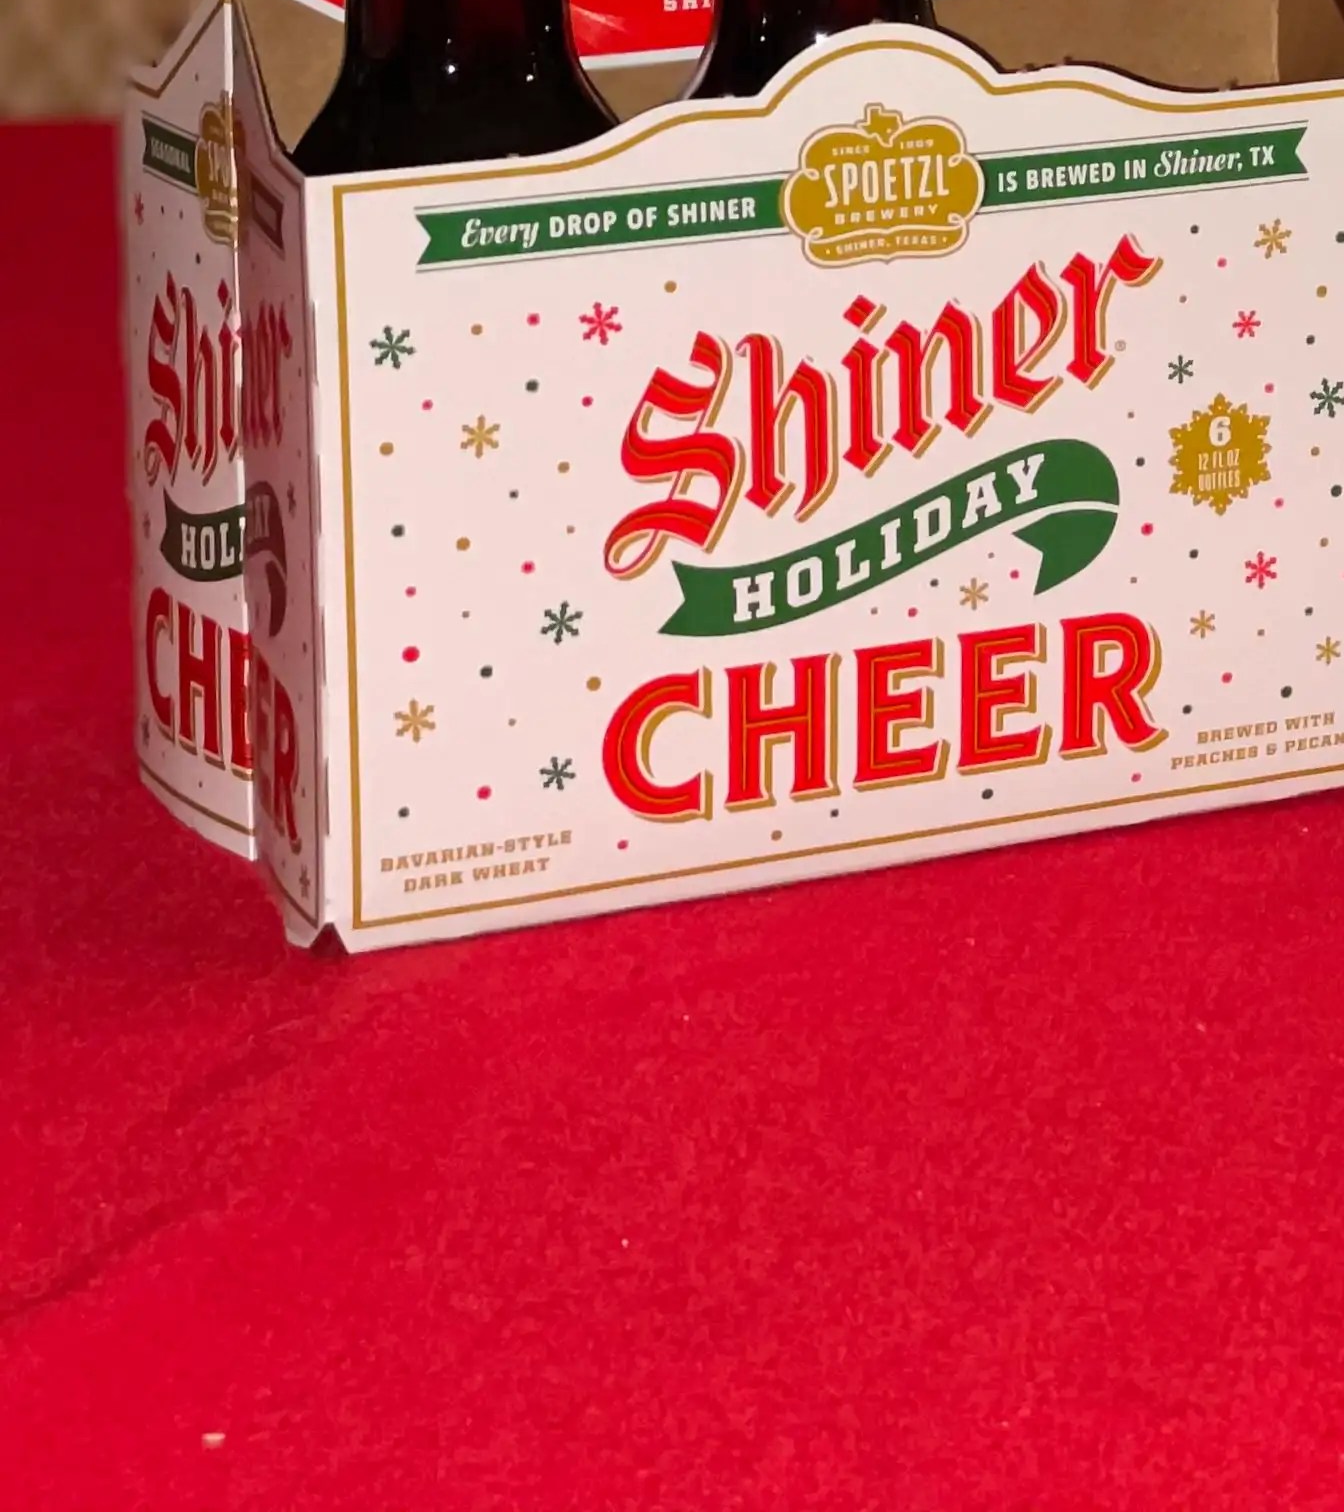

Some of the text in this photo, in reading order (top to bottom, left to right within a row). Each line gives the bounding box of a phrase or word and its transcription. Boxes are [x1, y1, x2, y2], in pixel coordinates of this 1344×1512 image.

[824, 154, 950, 208] SPOETZL
[998, 145, 1275, 193] IS BREWED IN Shiner, TX
[461, 197, 756, 249] Every DROP OF SHINER
[835, 204, 938, 225] BREWERY
[896, 235, 937, 247] TEXAS
[603, 233, 1163, 581] Shiner
[1209, 416, 1231, 447] 6
[1198, 448, 1240, 471] 12 FL OZ
[733, 453, 1045, 622] HOLIDAY
[602, 612, 1169, 823] CHEER
[1197, 712, 1335, 744] BREWED WITH
[1170, 745, 1259, 770] PEACHES
[1266, 743, 1277, 757] &
[380, 829, 572, 873] BAVARIAN-STYLE
[403, 857, 551, 893] DARK WHEAT
